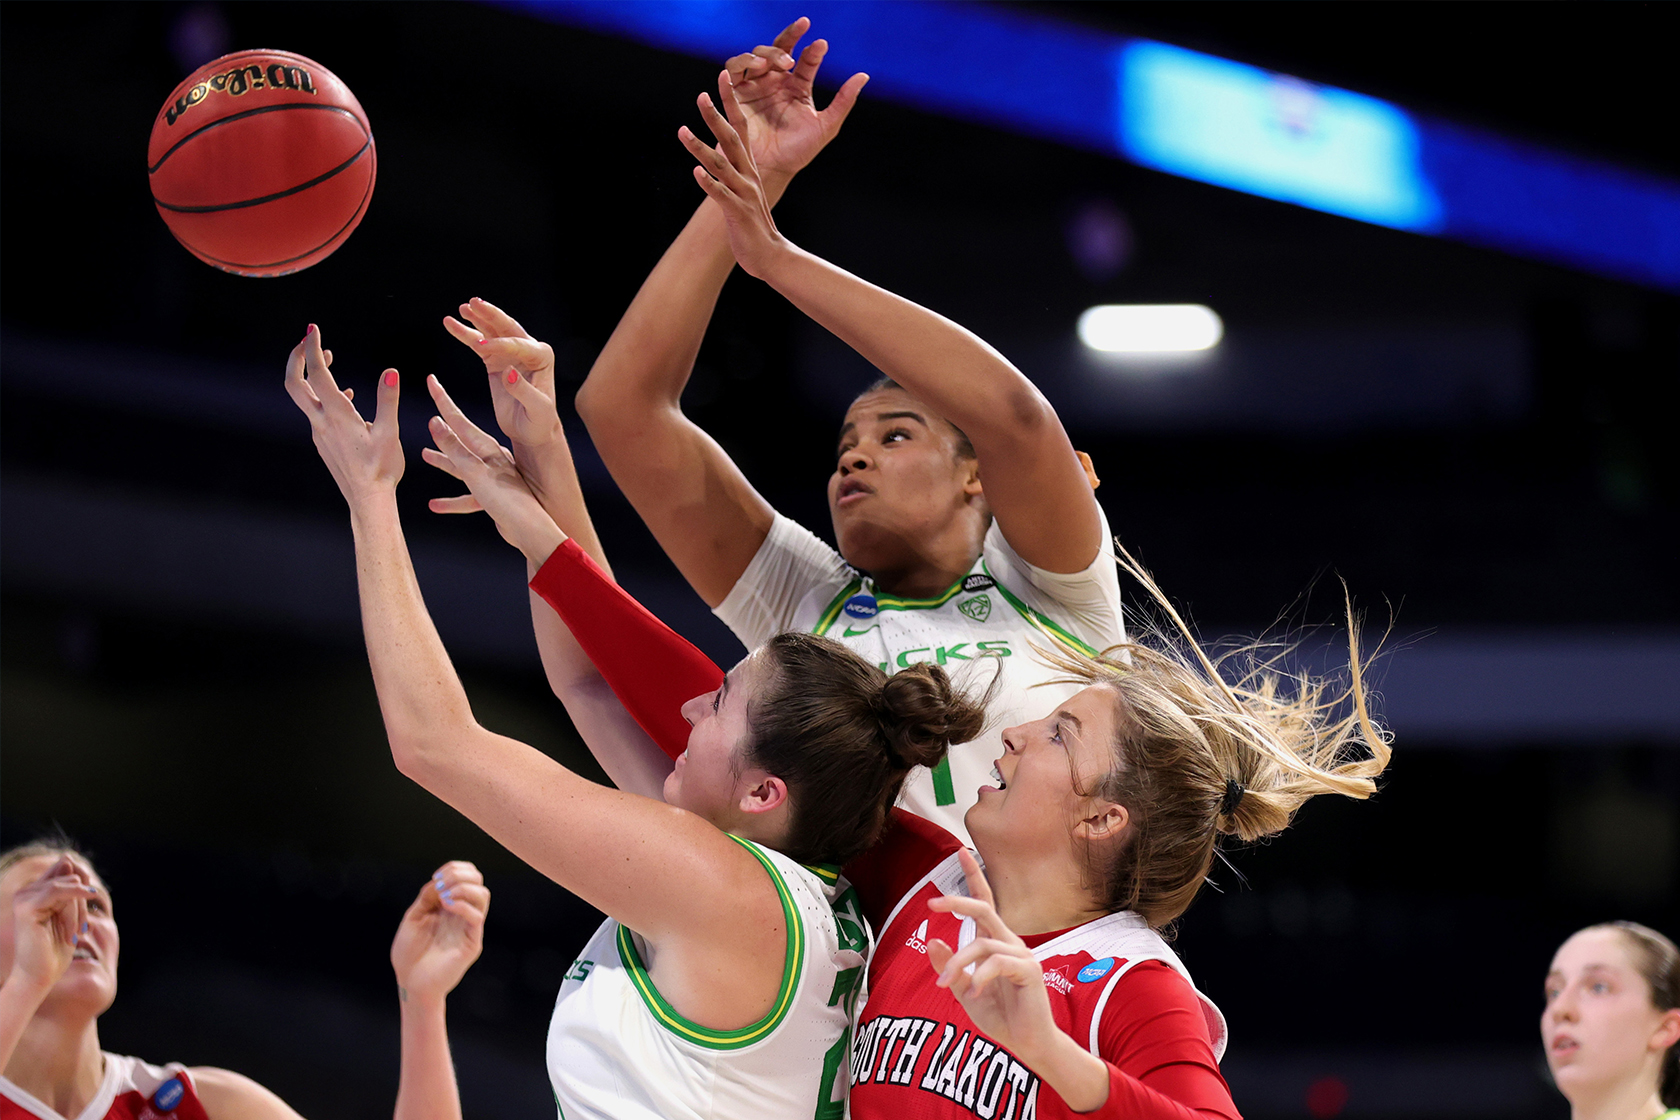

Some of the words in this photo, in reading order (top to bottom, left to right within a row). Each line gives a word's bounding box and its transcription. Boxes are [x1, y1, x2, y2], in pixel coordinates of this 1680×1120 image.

[163, 64, 318, 126] Wilson
[905, 936, 928, 954] das
[1081, 967, 1107, 977] NCAA
